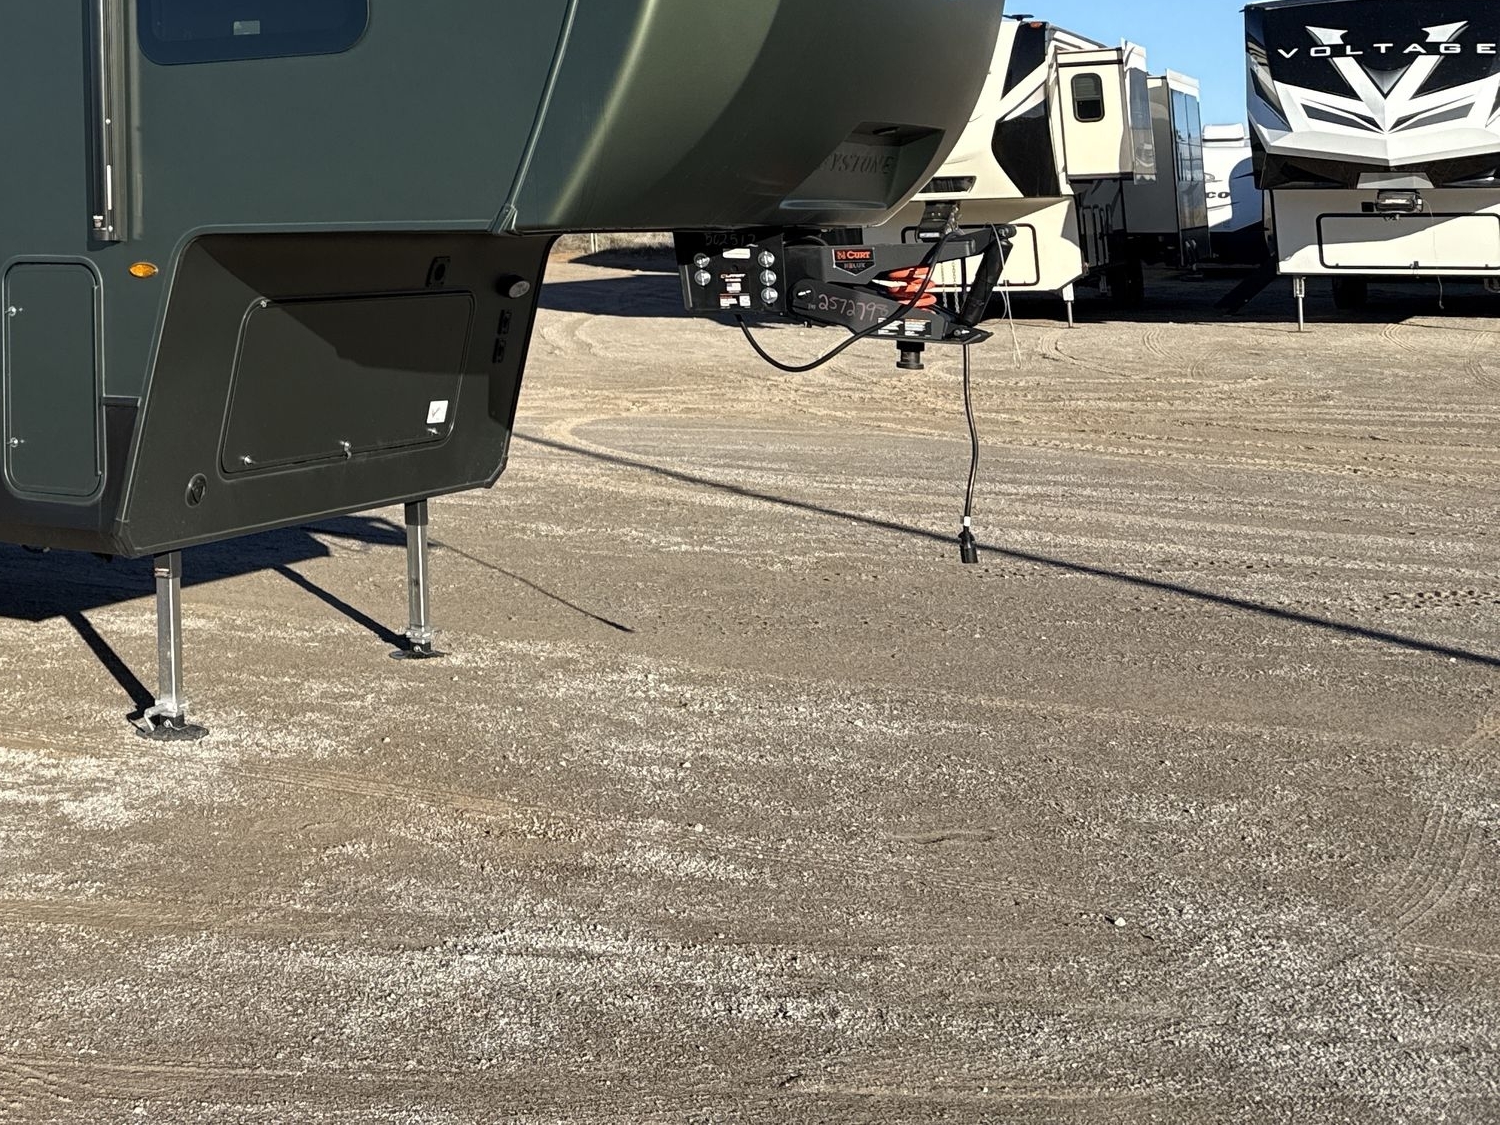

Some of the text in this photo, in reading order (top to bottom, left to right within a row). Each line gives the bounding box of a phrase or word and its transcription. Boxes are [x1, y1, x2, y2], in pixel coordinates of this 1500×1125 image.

[1277, 41, 1497, 59] VOLTAGE
[823, 153, 896, 174] YSTONE
[846, 250, 871, 260] CURT
